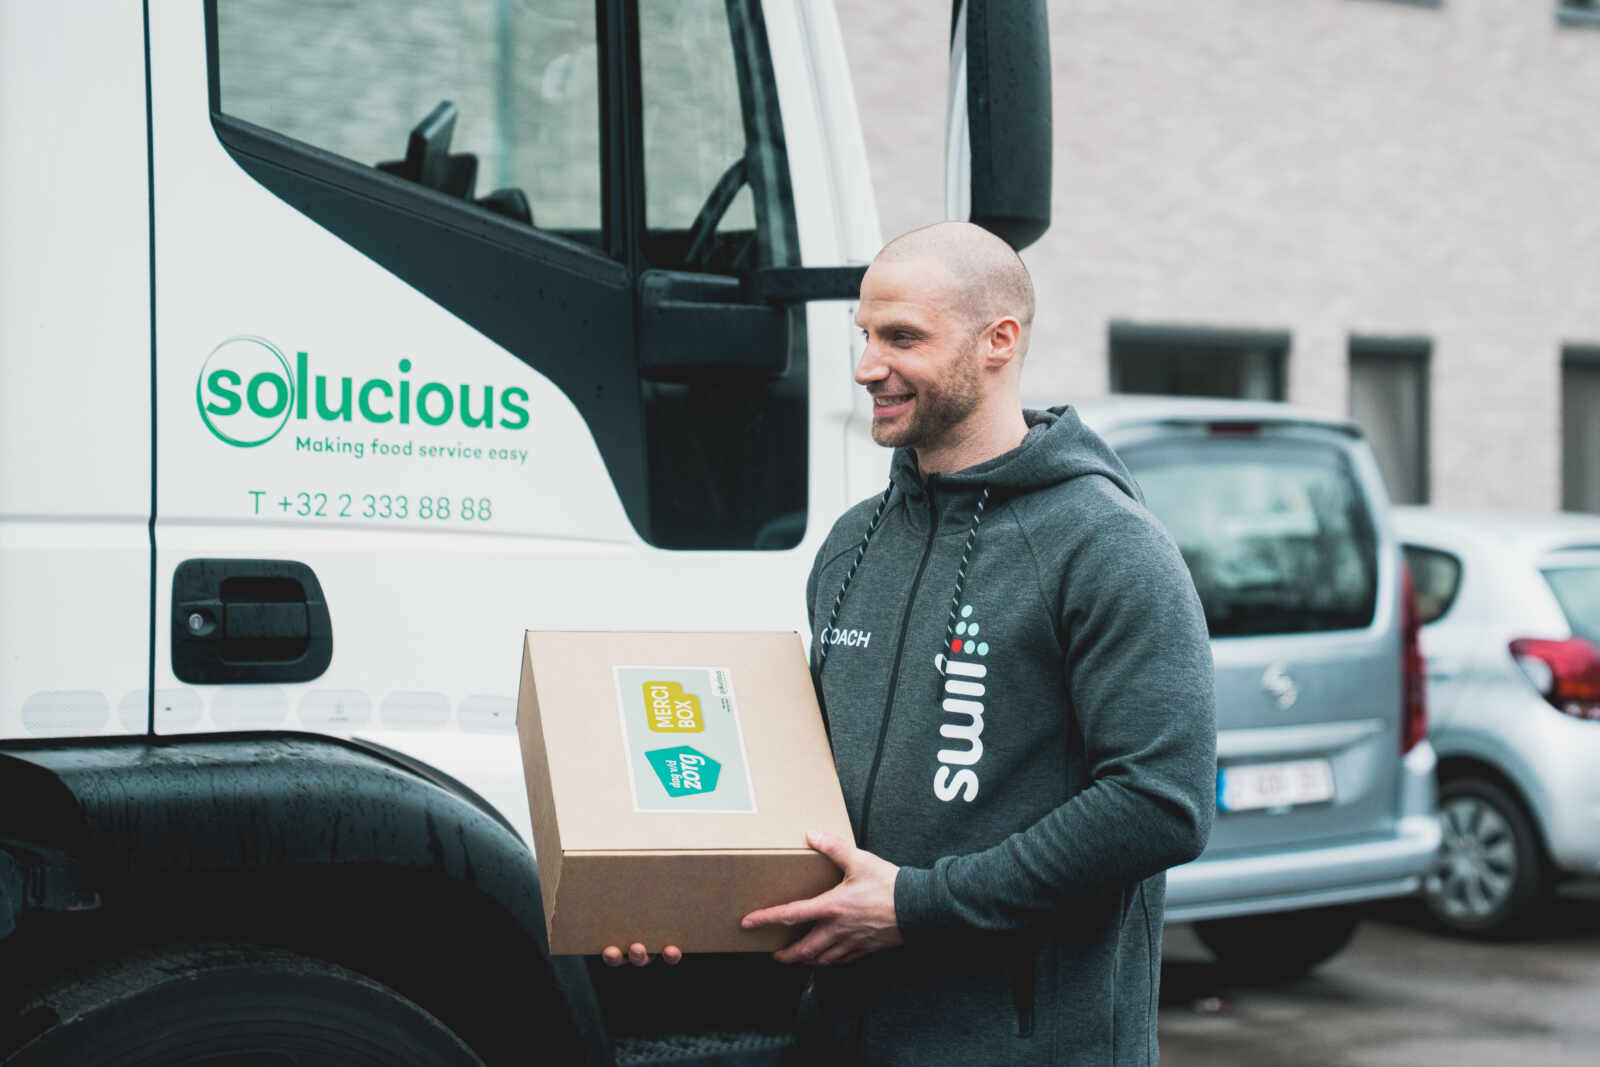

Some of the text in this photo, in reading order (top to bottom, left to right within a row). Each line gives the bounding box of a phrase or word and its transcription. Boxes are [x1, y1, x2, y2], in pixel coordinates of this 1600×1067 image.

[206, 352, 530, 430] solucious
[295, 436, 529, 465] Making food service easy
[248, 491, 493, 521] T +32 2 333 88 88
[650, 685, 674, 728] MERCI
[674, 699, 697, 728] BOX
[668, 774, 682, 788] dag
[678, 753, 706, 790] zorg
